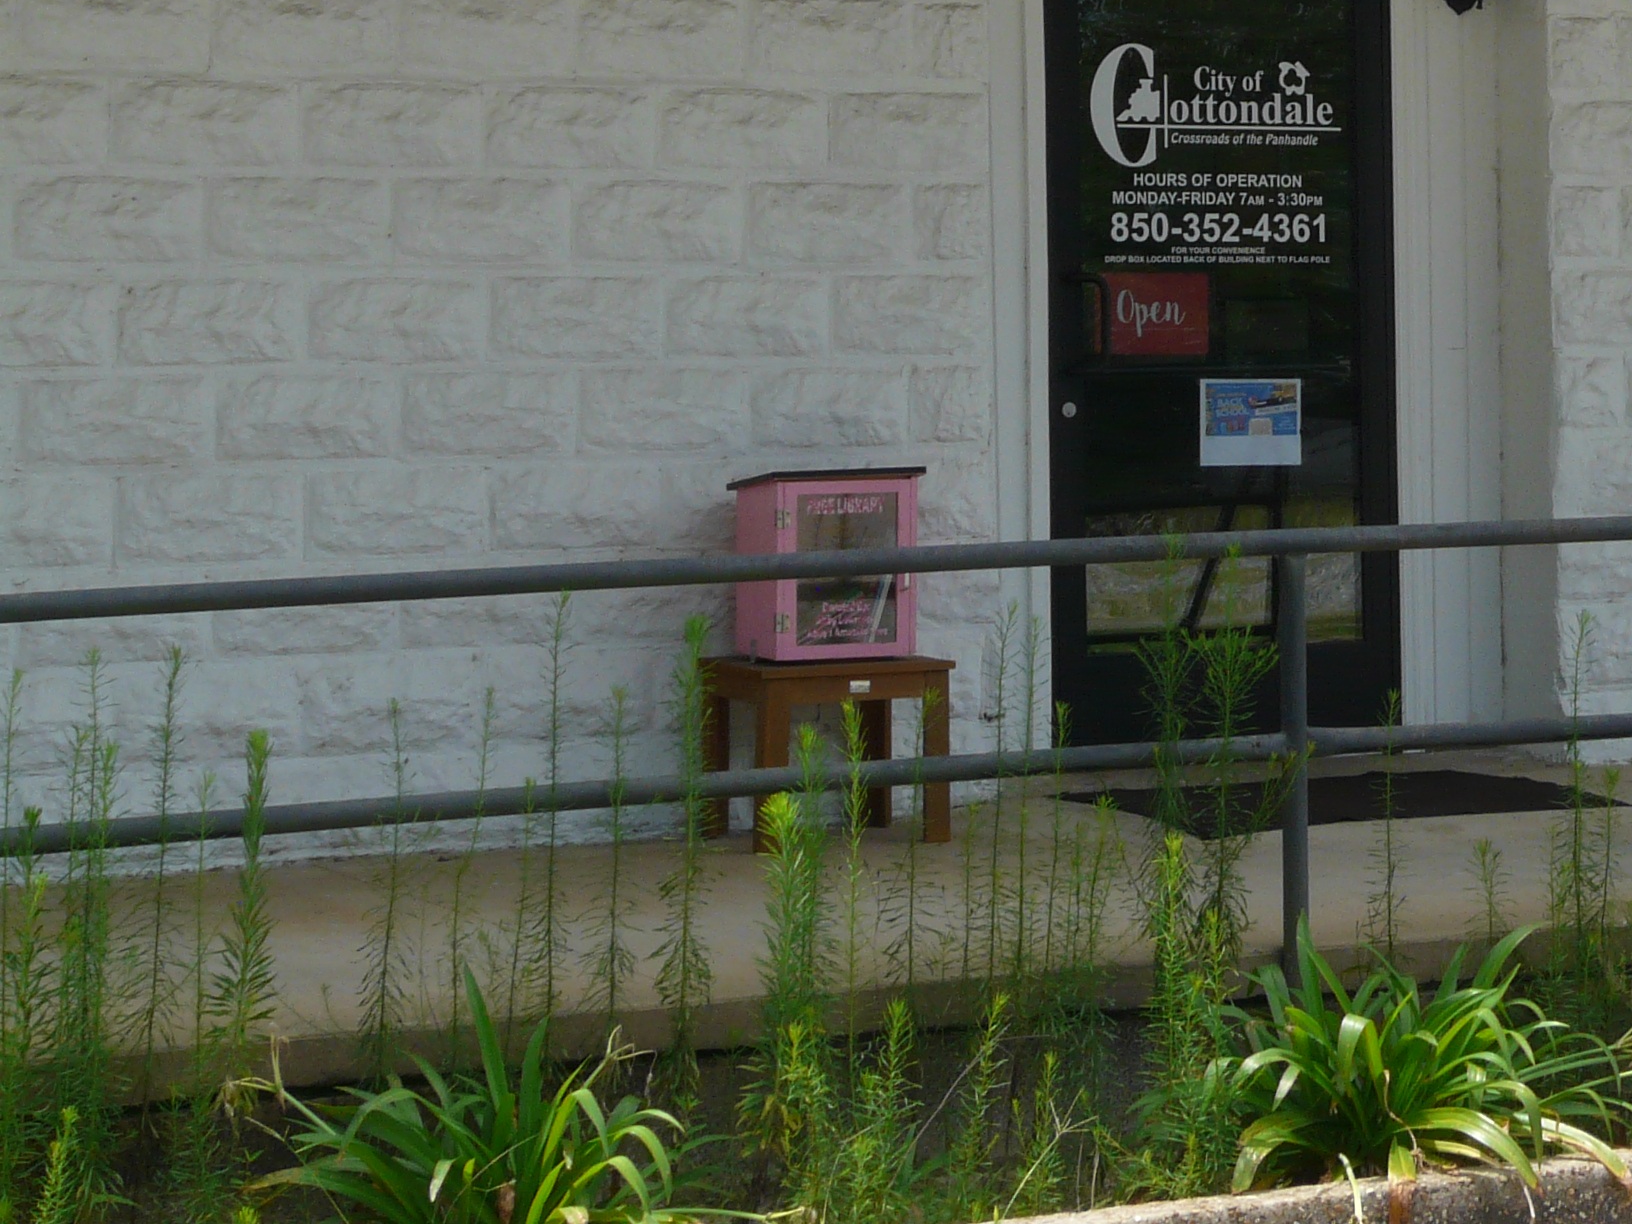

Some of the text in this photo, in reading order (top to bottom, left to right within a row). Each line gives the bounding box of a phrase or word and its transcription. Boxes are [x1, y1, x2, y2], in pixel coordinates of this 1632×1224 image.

[1194, 66, 1264, 97] City of
[1171, 132, 1318, 146] Crossroads of the Panhandle
[1133, 173, 1302, 188] HOURS OF OPERATION
[1112, 191, 1236, 205] MONDAY-FRIDAY
[1239, 192, 1264, 206] 7AM
[1277, 193, 1323, 206] 3:30PM
[1110, 212, 1326, 243] 850-352-4361
[1117, 289, 1186, 337] Open
